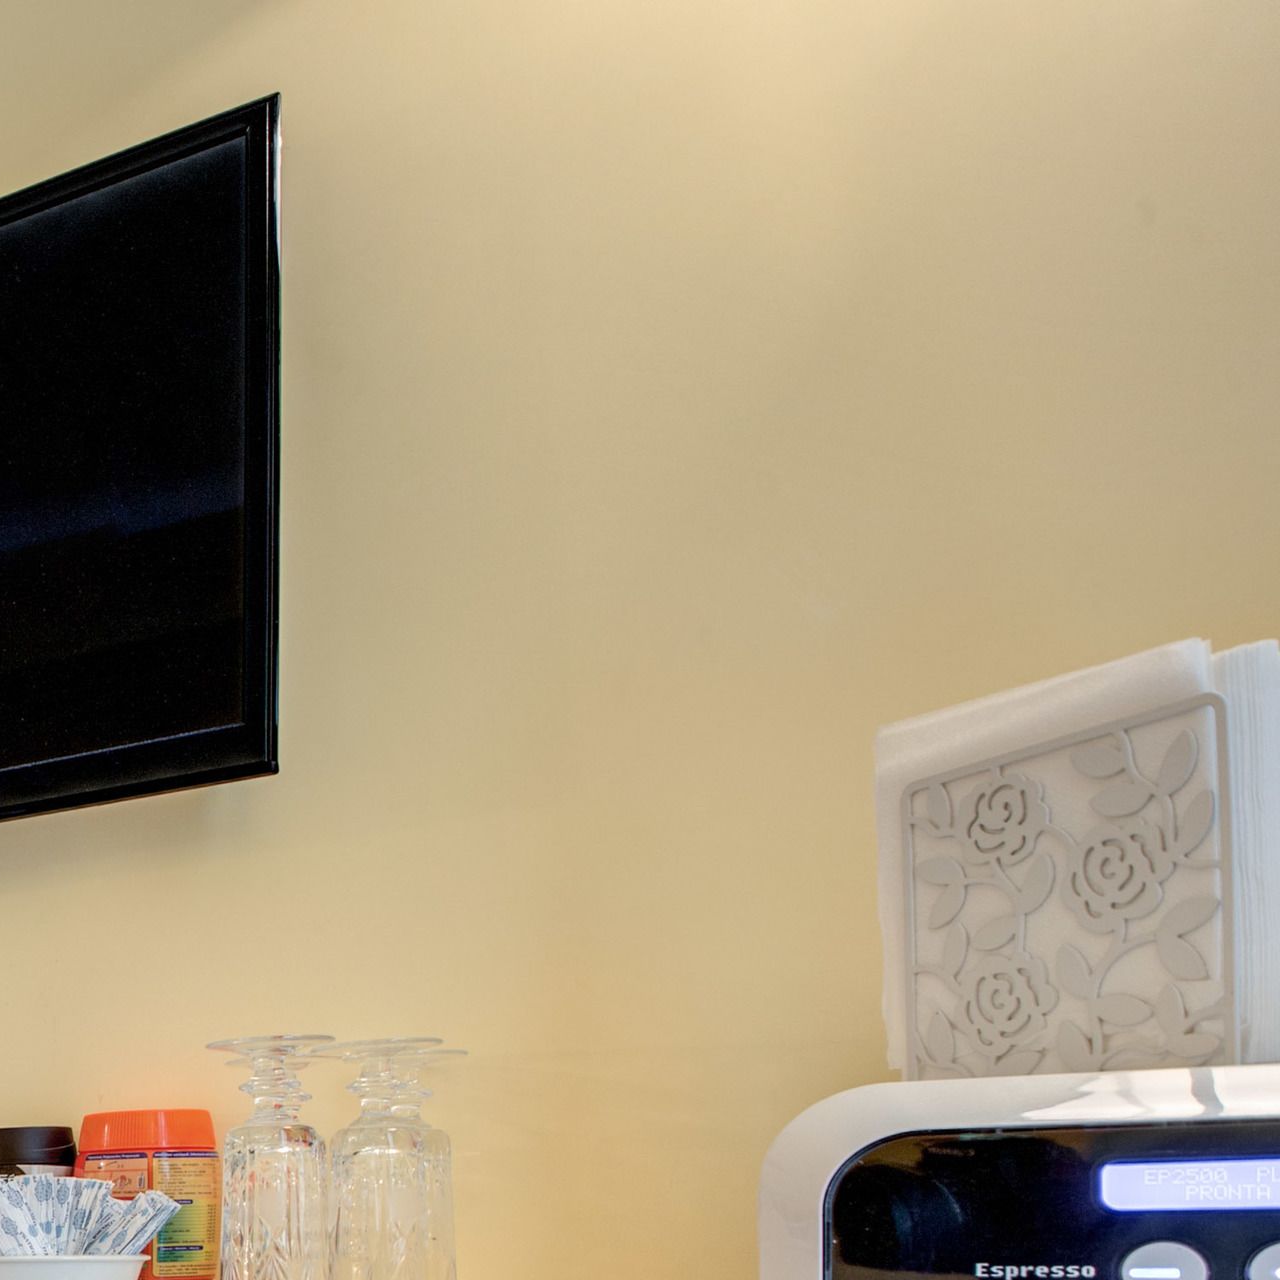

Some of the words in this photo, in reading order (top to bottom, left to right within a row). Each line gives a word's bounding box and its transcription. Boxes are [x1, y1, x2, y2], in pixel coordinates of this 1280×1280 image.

[1144, 1168, 1228, 1185] EP2500
[1185, 1184, 1271, 1200] PRONTA
[975, 1261, 1096, 1280] Espresso
